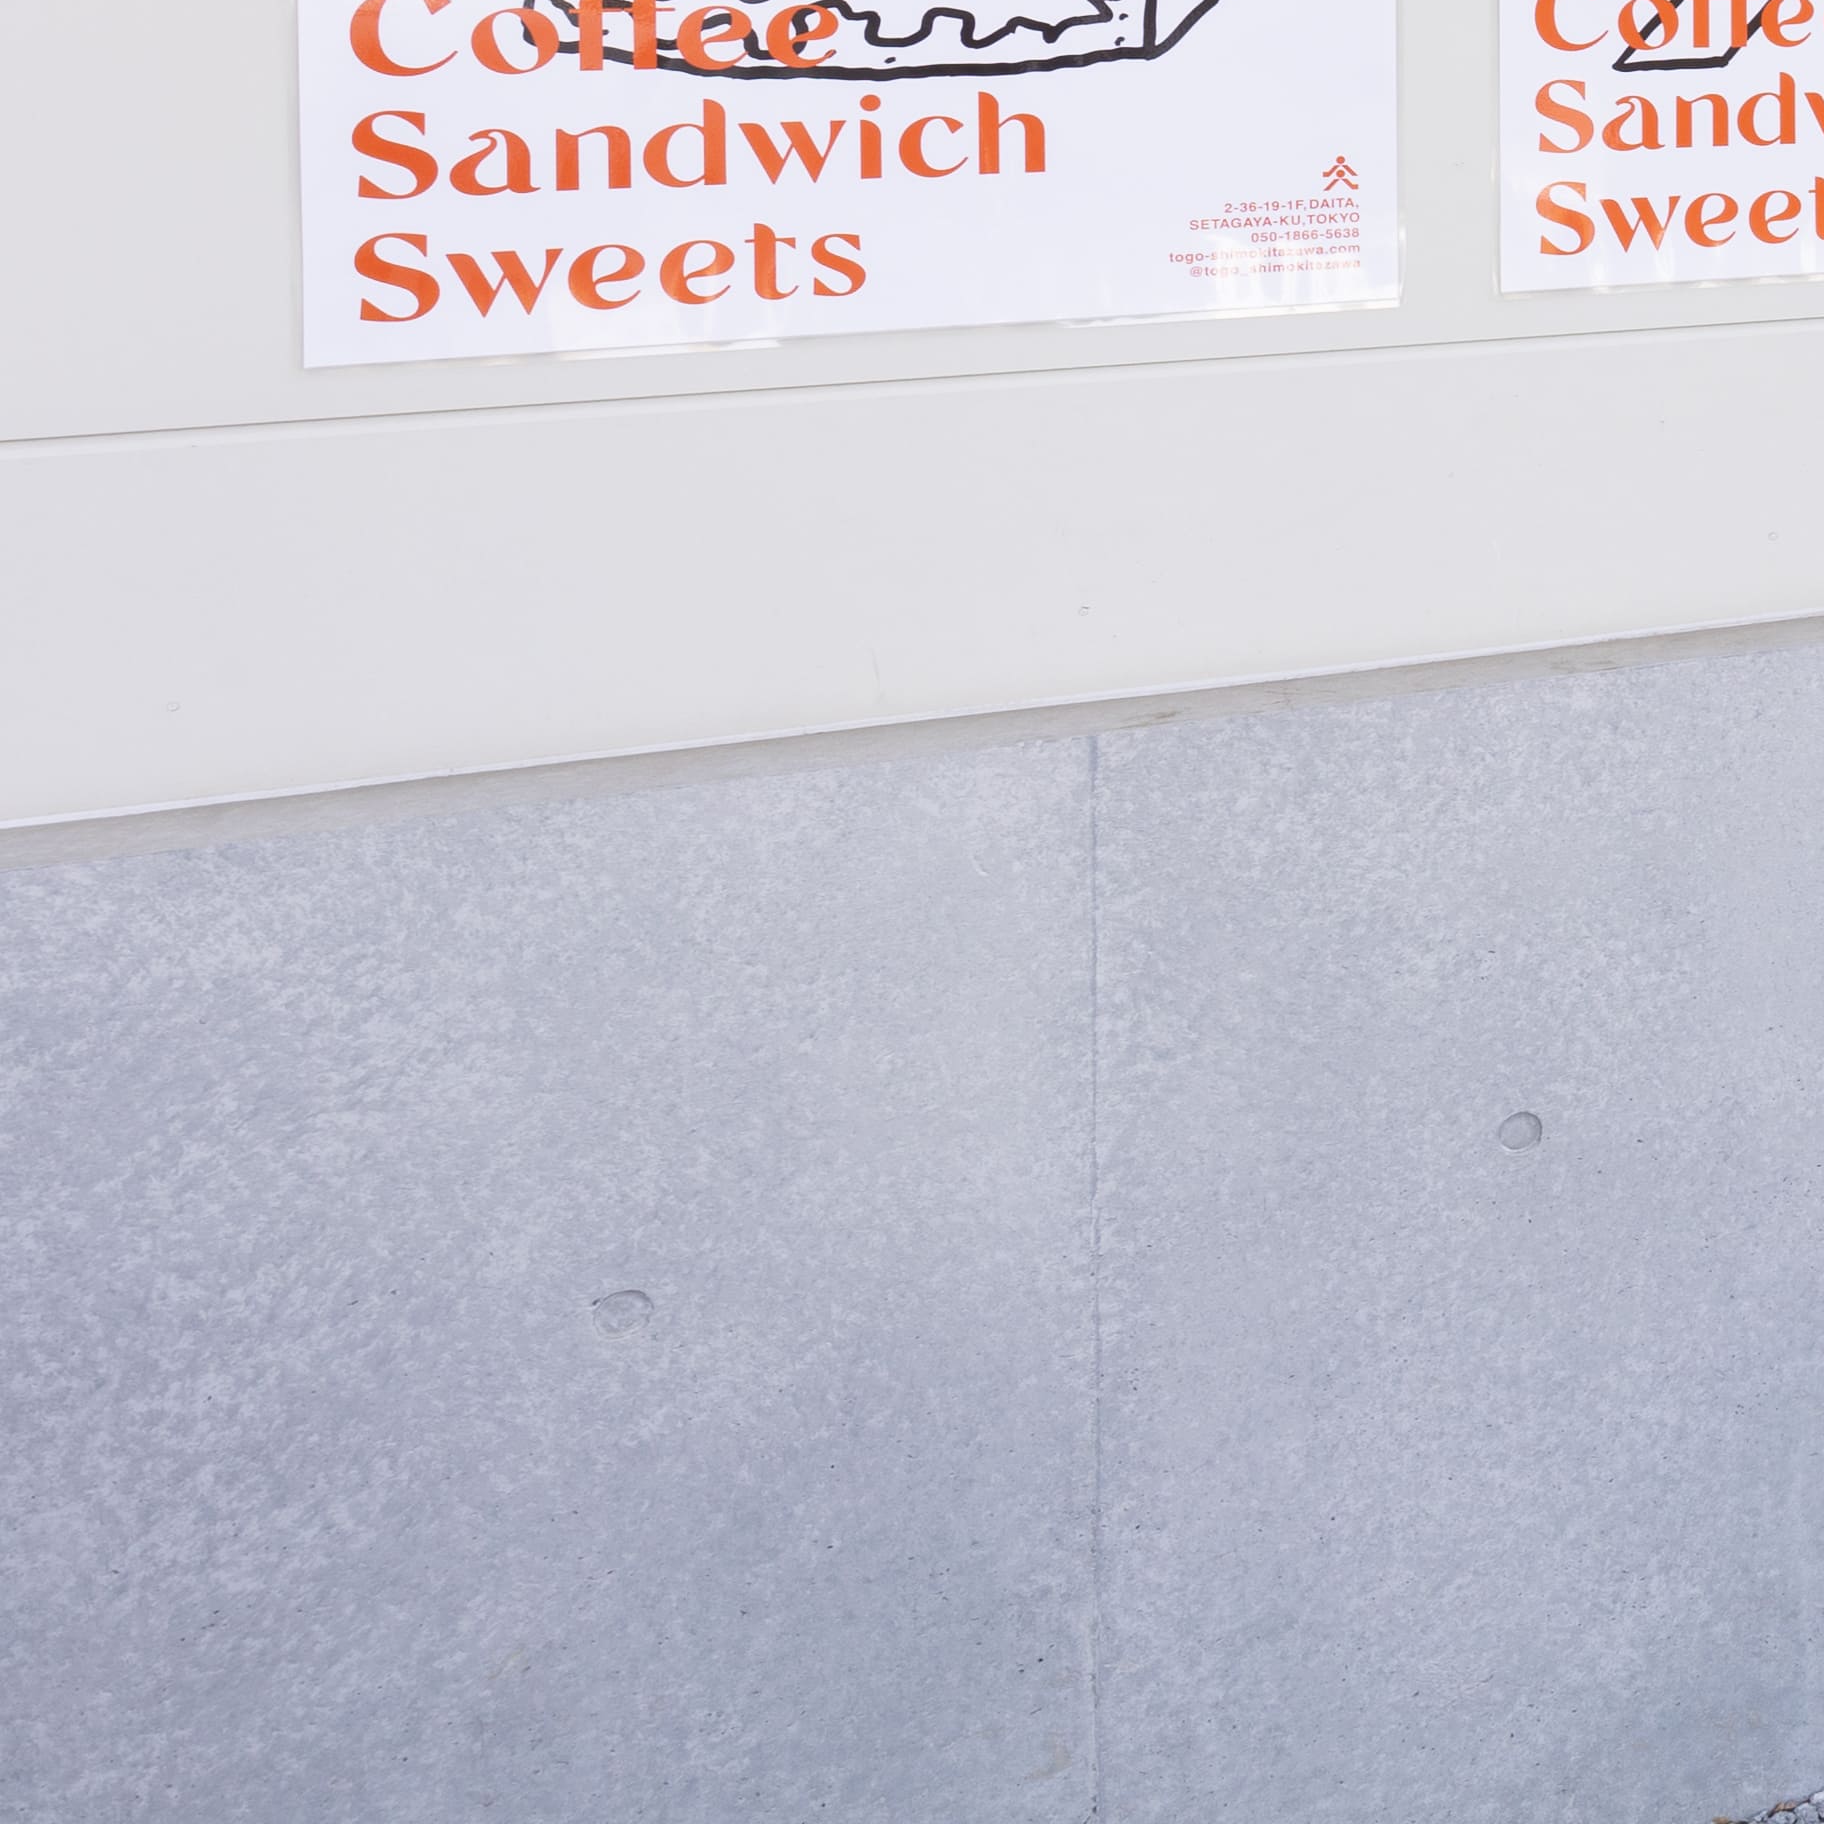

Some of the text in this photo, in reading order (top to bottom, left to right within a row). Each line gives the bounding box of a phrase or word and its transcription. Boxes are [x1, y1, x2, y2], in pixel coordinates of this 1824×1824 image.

[350, 91, 1048, 202] Sandwich
[355, 223, 867, 324] Sweets
[1251, 227, 1360, 243] 050-1866-5638
